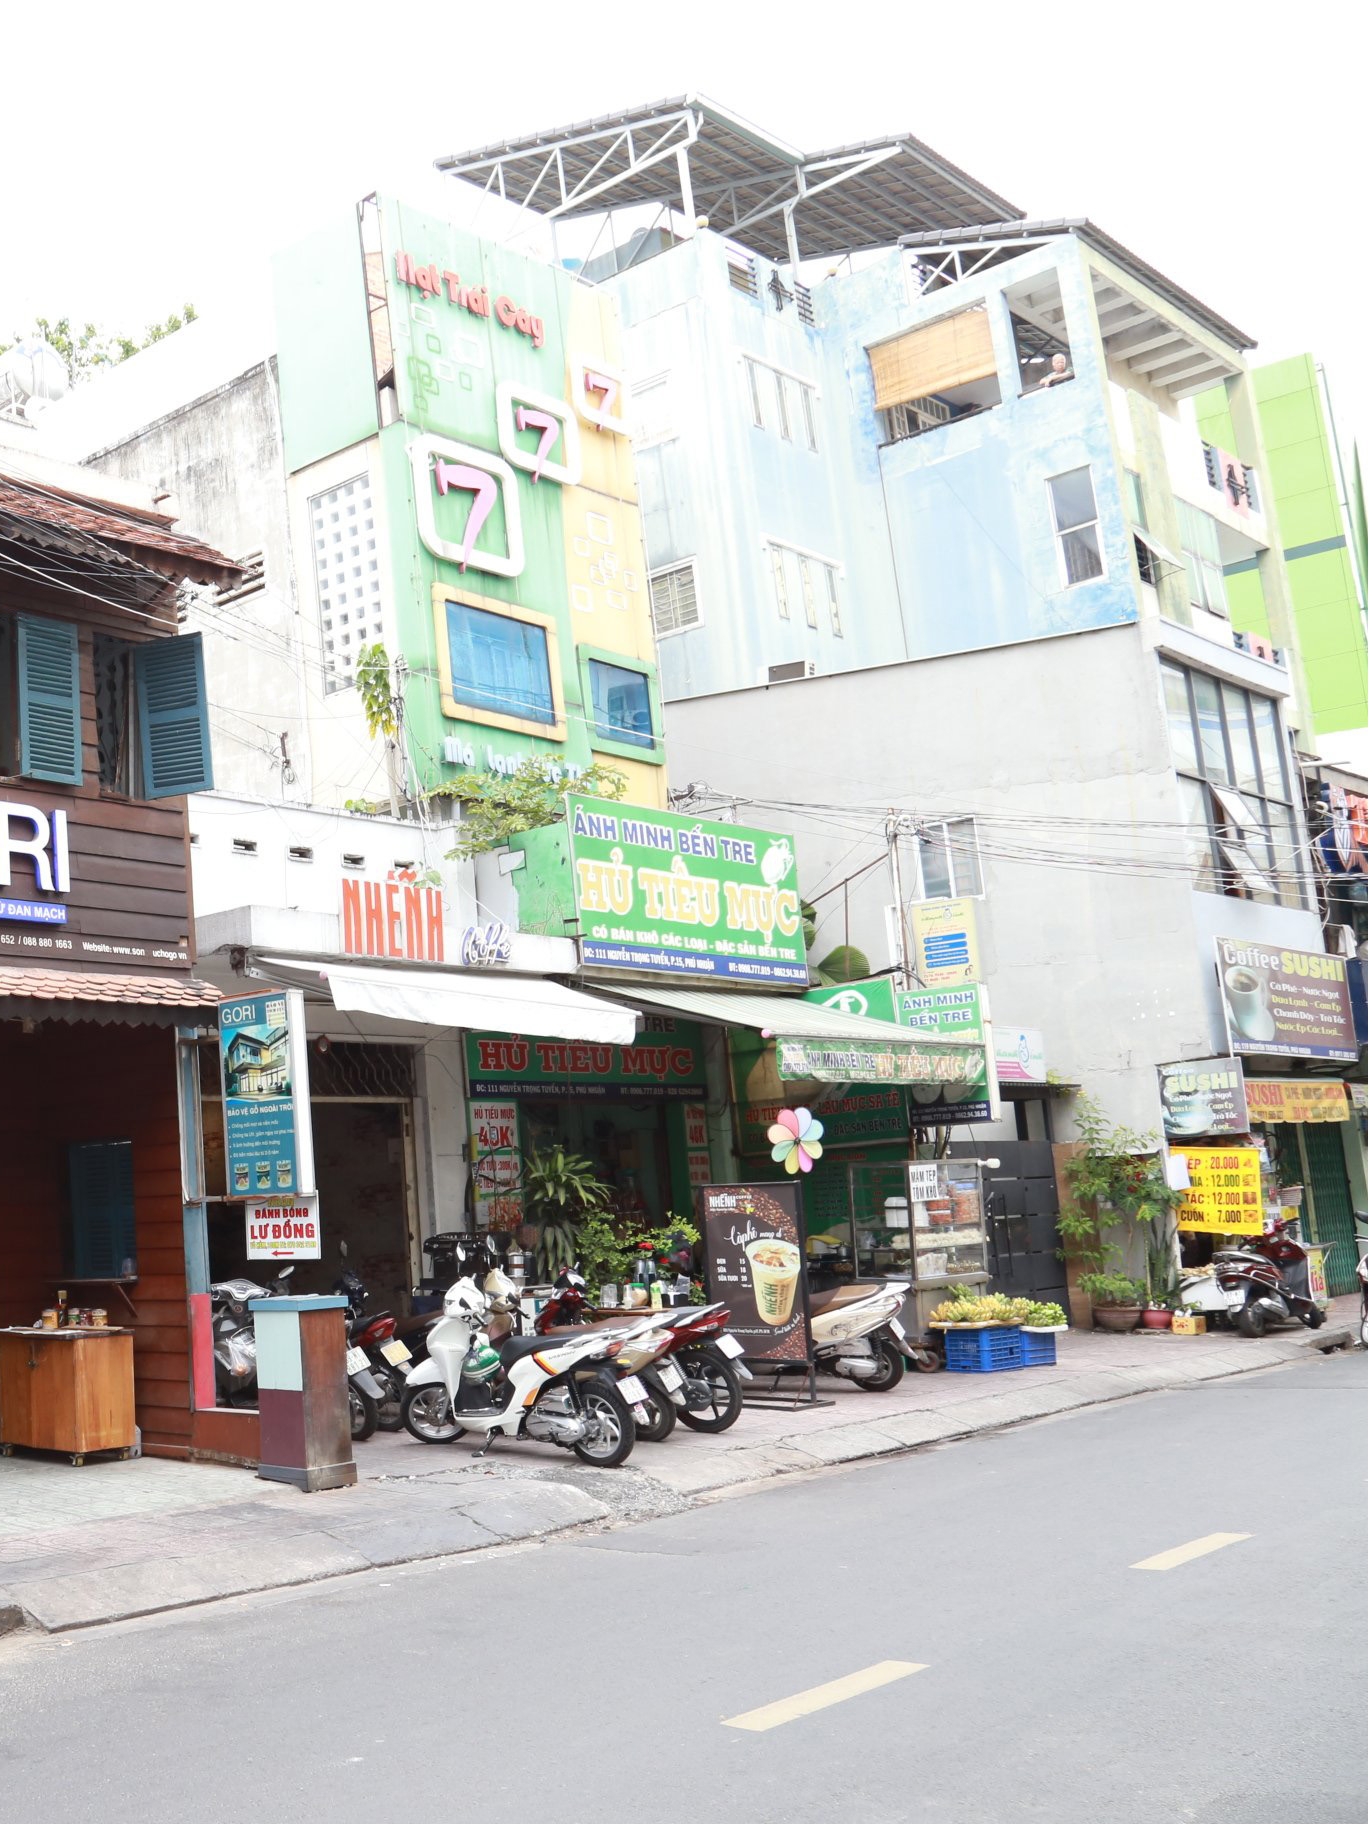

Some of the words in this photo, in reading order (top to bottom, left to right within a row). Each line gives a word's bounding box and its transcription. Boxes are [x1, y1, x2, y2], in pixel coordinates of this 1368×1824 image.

[443, 271, 491, 318] Trái
[585, 372, 617, 432] 7
[516, 406, 559, 484] 7
[436, 459, 498, 574] 7
[622, 819, 674, 851] MINH
[678, 824, 717, 858] BẾN
[720, 838, 756, 865] TRE
[576, 847, 634, 915] HỦ
[724, 880, 800, 944] MỰC
[8, 905, 32, 917] ĐAN
[34, 906, 66, 922] MẠCH
[0, 933, 15, 945] 652
[23, 935, 37, 946] 088
[39, 937, 53, 948] 880
[55, 938, 73, 950] 1663
[82, 940, 112, 954] Website:
[592, 924, 608, 939] CÓ
[610, 926, 634, 943] BÁN
[595, 948, 607, 959] 111
[1223, 942, 1281, 971] Coffee
[1281, 951, 1346, 983] SUSHI
[936, 990, 974, 1006] MINH
[221, 1004, 256, 1025] GORI
[909, 1008, 939, 1027] BẾN
[942, 1011, 971, 1023] TRE
[477, 1034, 530, 1072] HỦ
[619, 1045, 695, 1081] MỰC
[487, 1084, 499, 1093] 111
[1164, 1071, 1239, 1095] SUSHI
[1245, 1083, 1285, 1106] SUSHI
[1187, 1156, 1201, 1170] ÉP
[1210, 1156, 1239, 1170] 20.000
[1211, 1174, 1240, 1188] 12.000
[1212, 1192, 1241, 1205] 12.000
[255, 1207, 281, 1219] ĐÁNH
[1180, 1207, 1205, 1222] CUỐN
[1217, 1210, 1242, 1223] 7.000
[250, 1222, 269, 1240] LƯ
[272, 1219, 315, 1239] ĐỒNG
